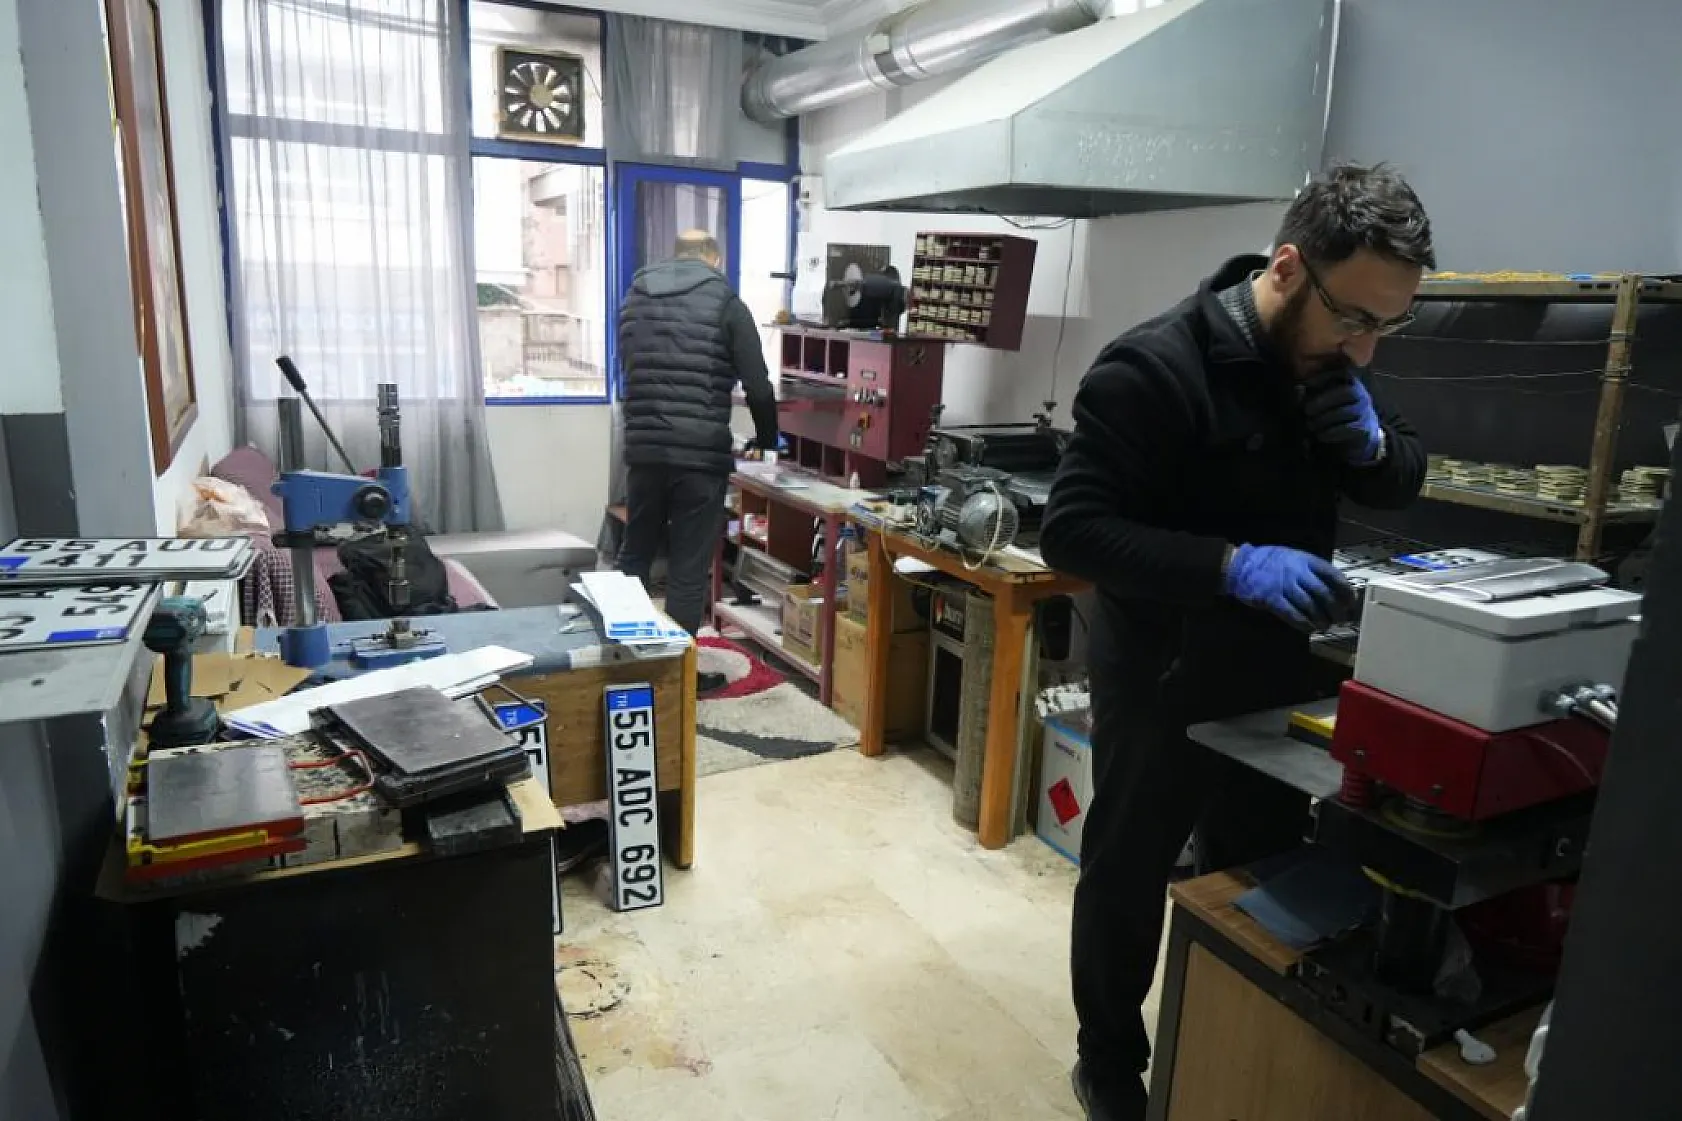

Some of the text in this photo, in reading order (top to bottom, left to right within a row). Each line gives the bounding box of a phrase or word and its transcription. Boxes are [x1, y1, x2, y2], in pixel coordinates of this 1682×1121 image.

[13, 540, 99, 552] 55
[39, 553, 148, 567] 411
[614, 710, 650, 750] 55
[616, 768, 653, 827] ADC
[621, 844, 658, 905] 692
